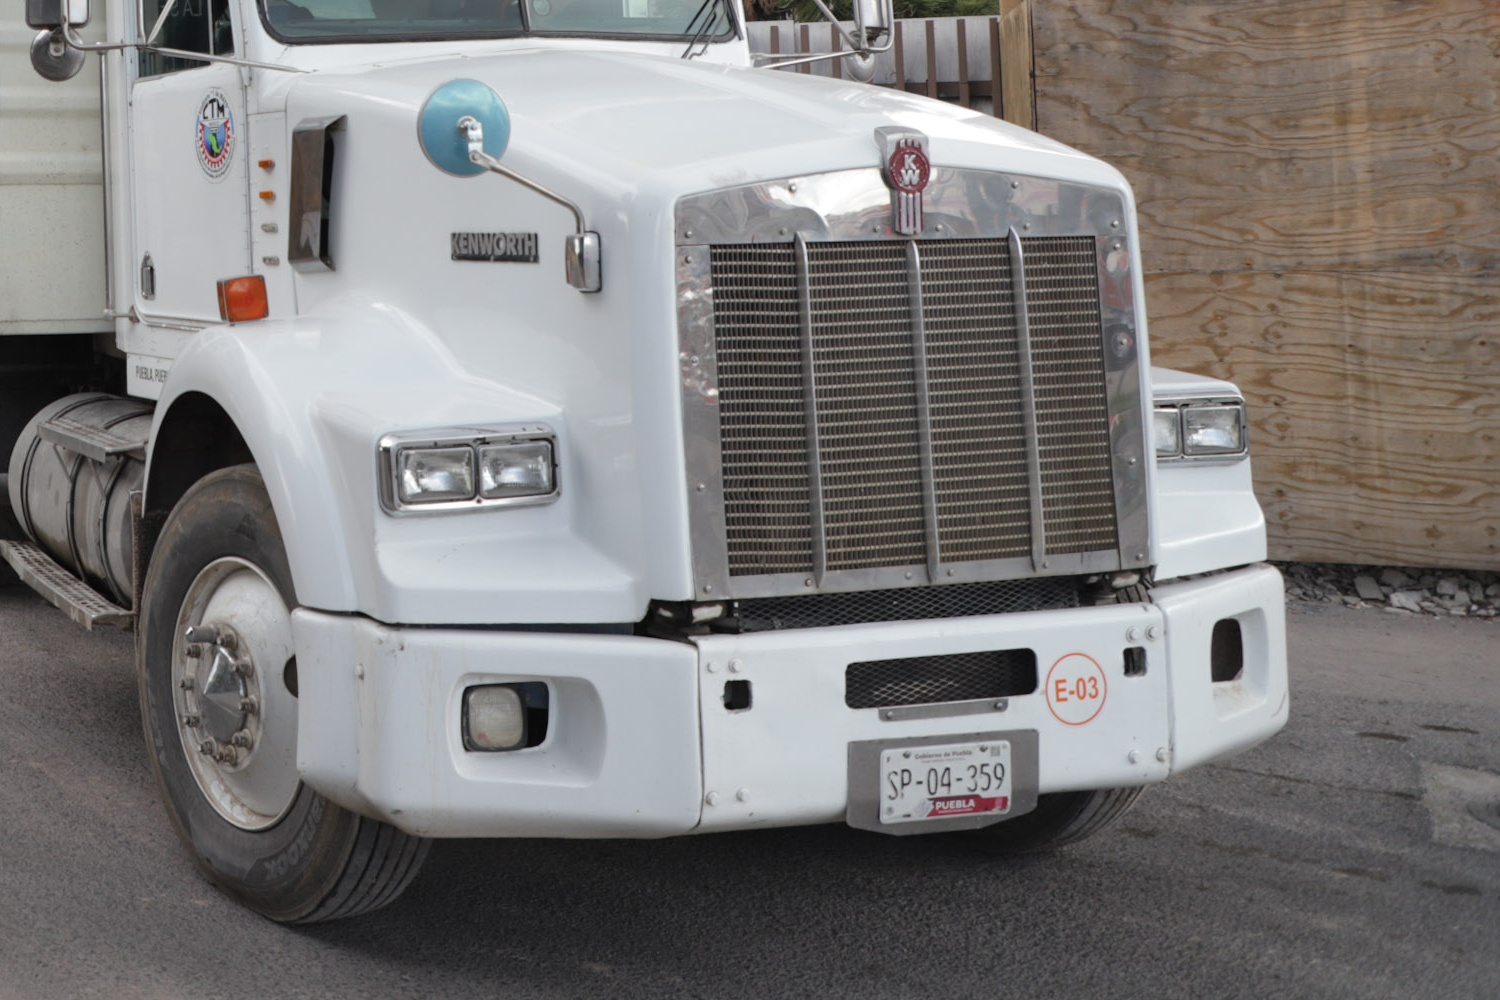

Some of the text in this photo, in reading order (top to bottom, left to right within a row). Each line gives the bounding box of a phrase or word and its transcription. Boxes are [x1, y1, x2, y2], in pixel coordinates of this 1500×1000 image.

[451, 232, 537, 256] KENWORTH
[1055, 676, 1099, 703] E-03
[887, 762, 1005, 801] SP-04-359
[935, 799, 976, 811] PUEBLA
